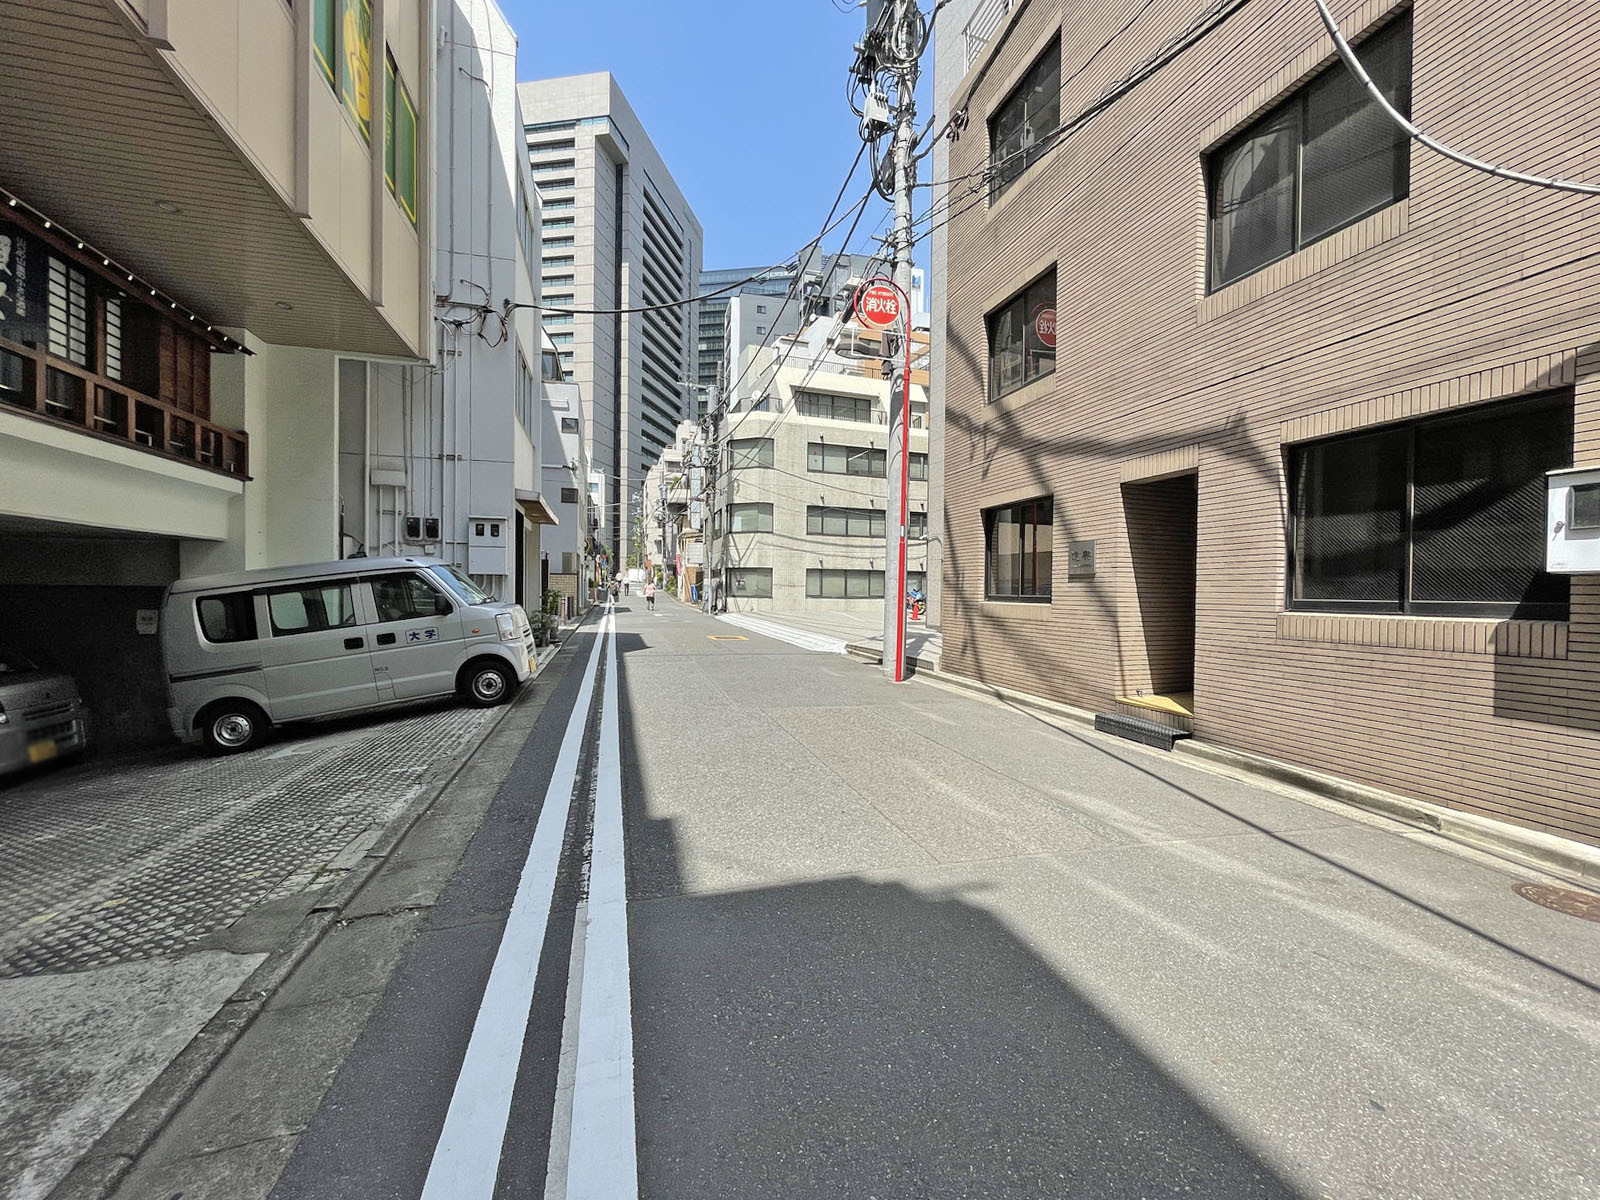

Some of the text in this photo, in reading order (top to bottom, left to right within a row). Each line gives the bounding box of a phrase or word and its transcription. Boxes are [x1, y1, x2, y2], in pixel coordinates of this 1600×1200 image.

[866, 297, 897, 314] 消火栓
[408, 629, 436, 641] 大学
